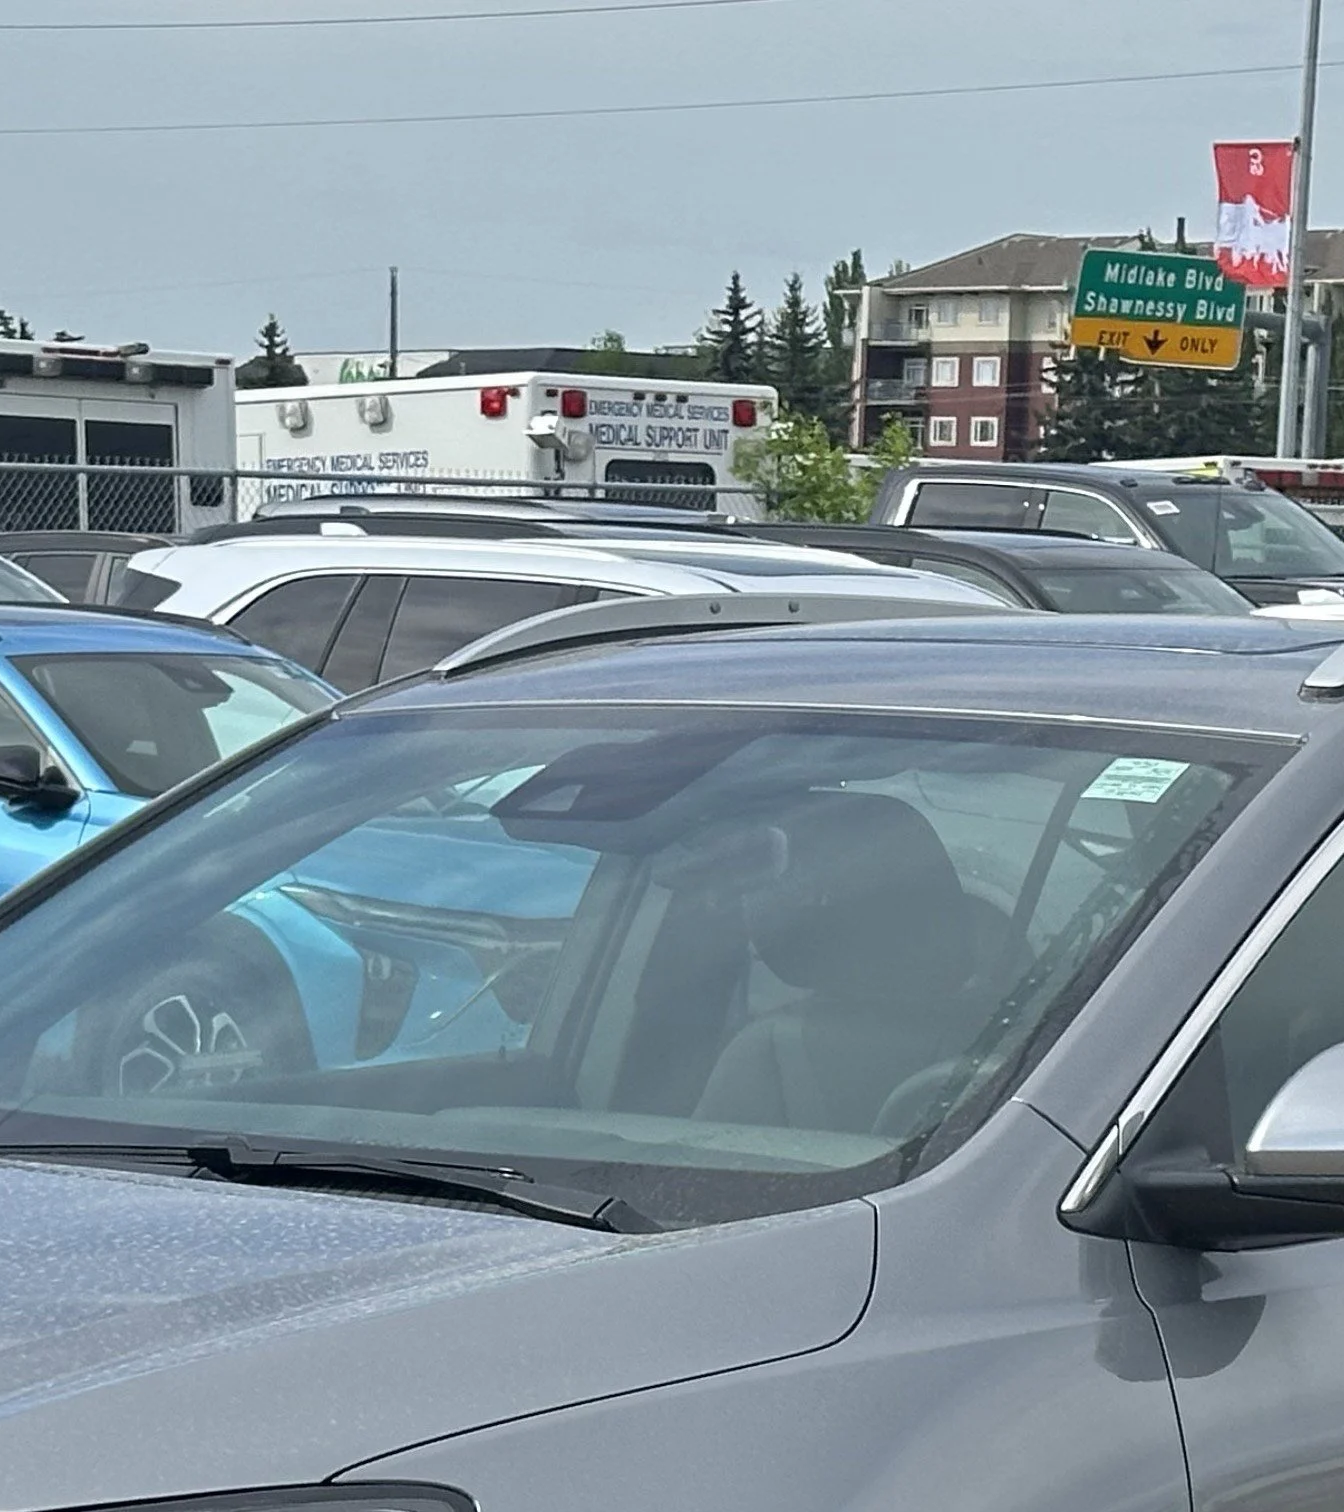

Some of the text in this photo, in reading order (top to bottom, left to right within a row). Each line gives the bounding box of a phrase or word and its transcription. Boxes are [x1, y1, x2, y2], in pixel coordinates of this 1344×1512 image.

[1103, 262, 1224, 292] Midlake Blvd
[1084, 291, 1236, 323] Shawnessy Blvd
[1097, 329, 1219, 354] EXIT ONLY
[588, 399, 730, 422] EMERGENCY MEDICAL SERVICES
[588, 422, 730, 450] MEDICAL SUPPORT UNIT
[266, 450, 429, 474] EMERGENCY MEDICAL SERVICES
